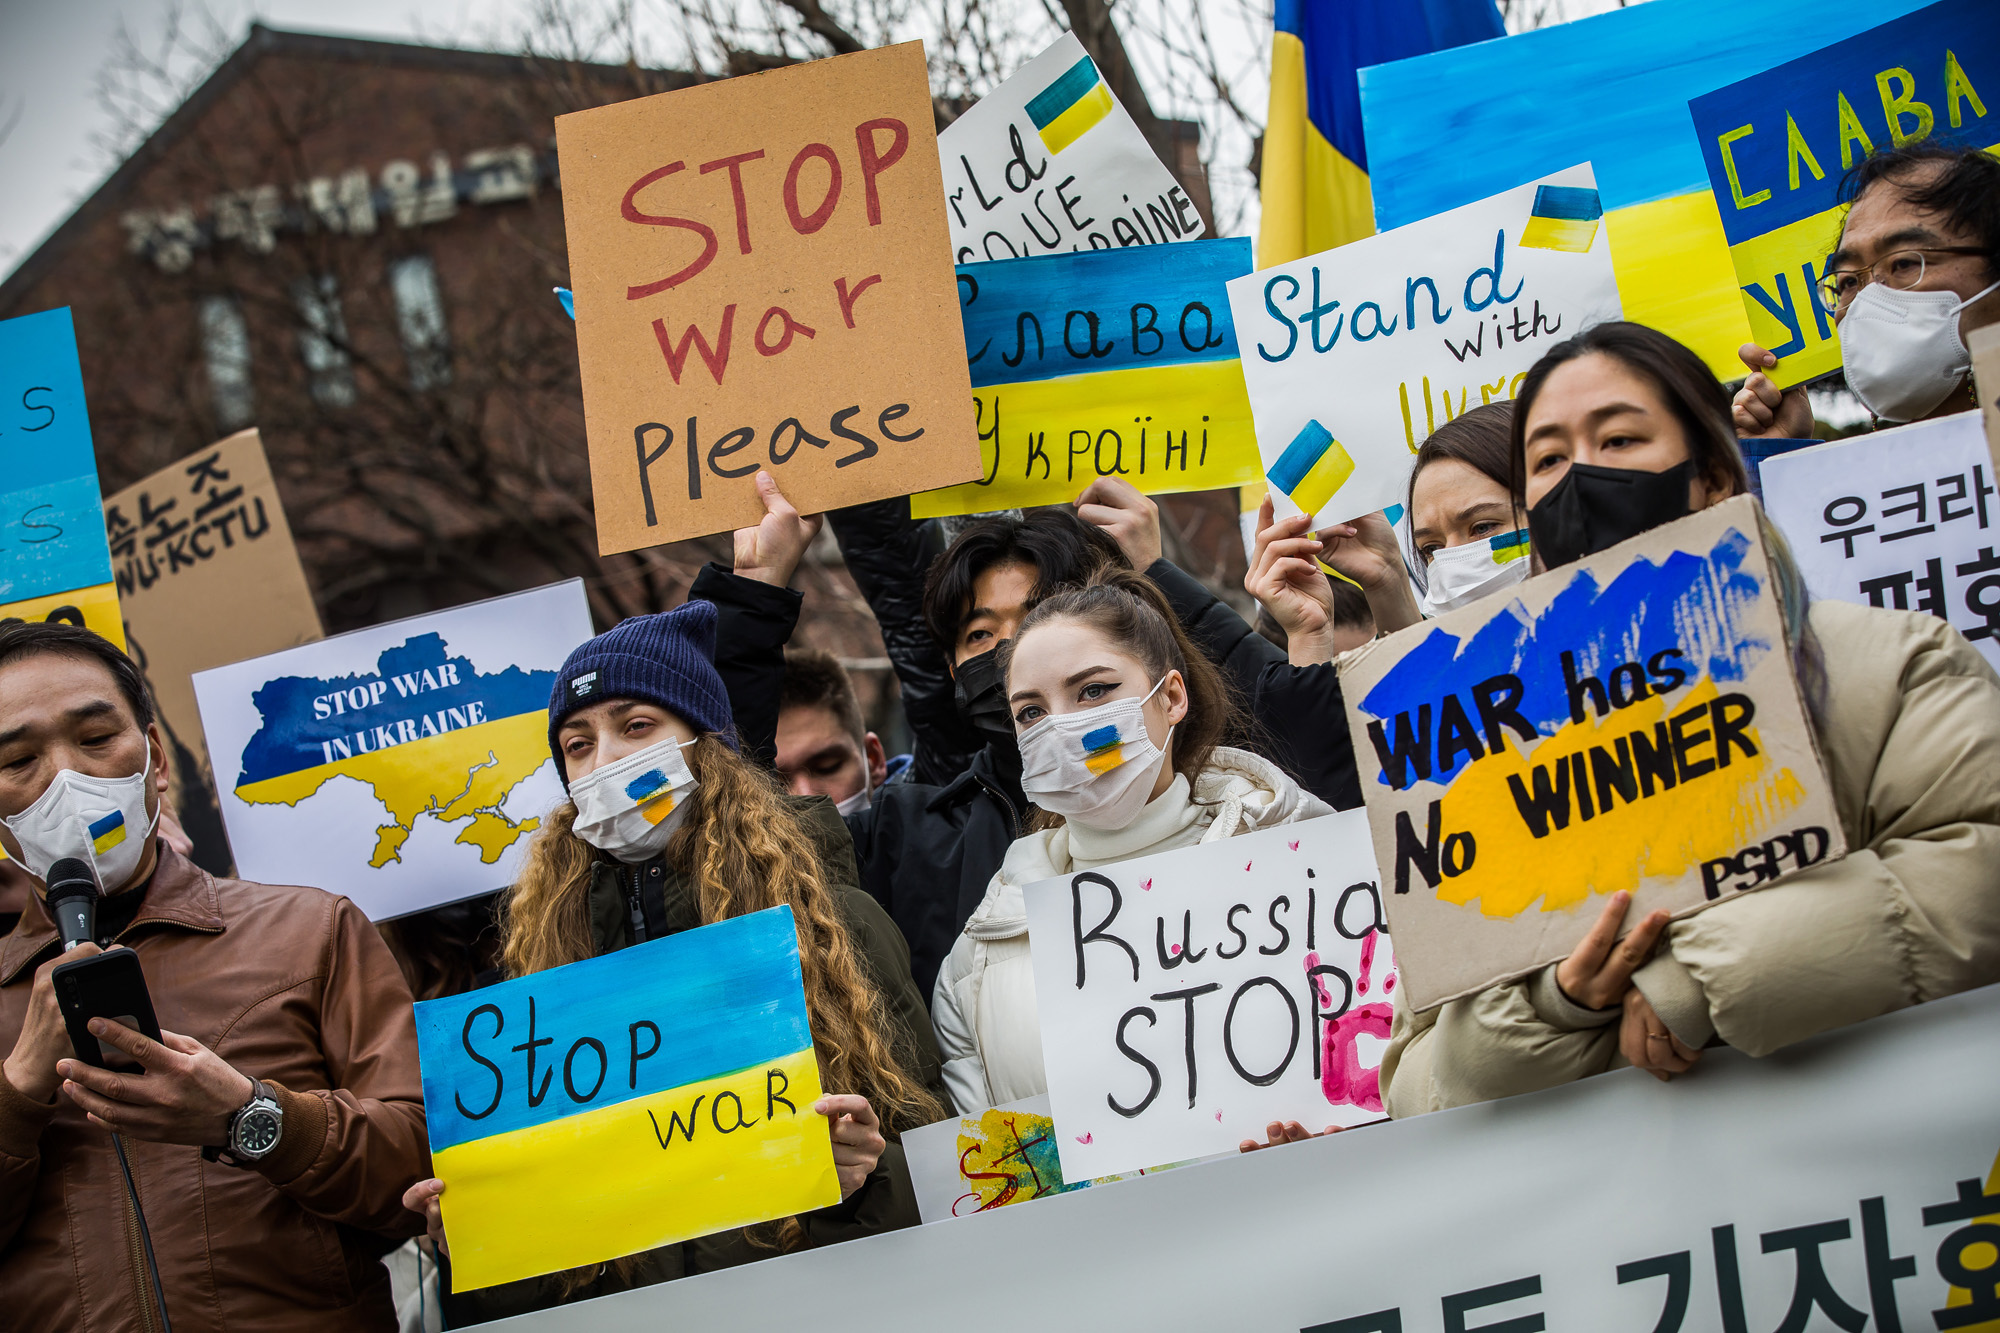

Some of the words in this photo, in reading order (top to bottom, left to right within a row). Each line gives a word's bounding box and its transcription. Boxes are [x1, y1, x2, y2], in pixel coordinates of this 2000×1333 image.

[620, 118, 910, 300] STOP
[1257, 229, 1524, 363] Stand
[313, 680, 387, 720] STOP
[391, 663, 461, 698] WAR
[321, 735, 352, 764] IN
[356, 701, 487, 754] UKRAINE
[571, 671, 597, 689] PUMA
[1366, 673, 1540, 791] WAR
[1560, 649, 1687, 725] has
[1394, 801, 1477, 894] No
[1507, 693, 1759, 839] WINNER
[1701, 826, 1830, 901] PSPD
[1072, 871, 1388, 989] Russia
[1108, 965, 1353, 1118] STOP
